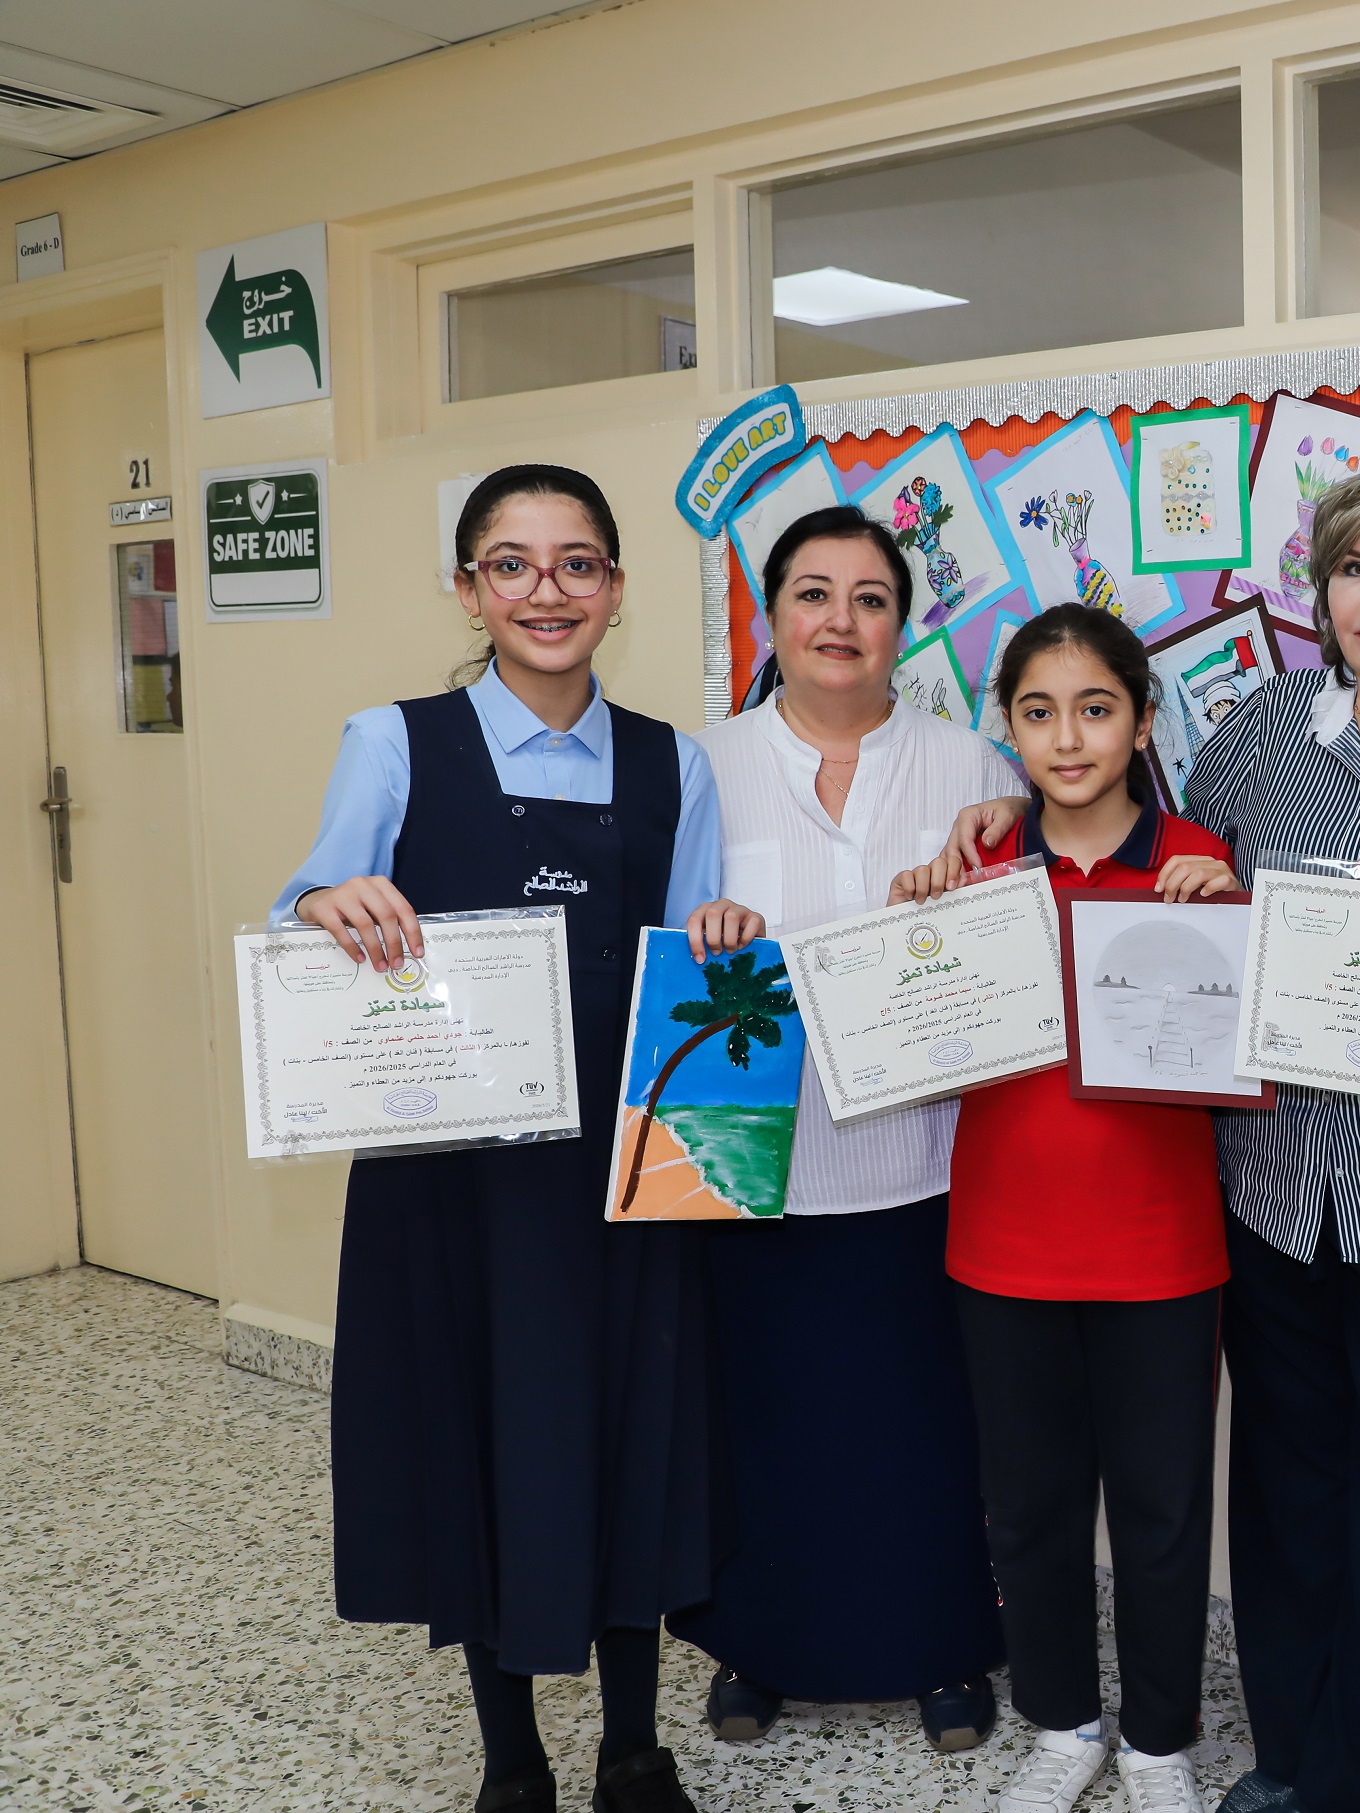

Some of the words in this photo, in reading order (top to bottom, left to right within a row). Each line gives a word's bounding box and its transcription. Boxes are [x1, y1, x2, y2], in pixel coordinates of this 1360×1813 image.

[20, 242, 42, 257] Grade
[43, 240, 48, 252] 6
[53, 237, 60, 249] D
[242, 275, 292, 315] خروج
[243, 310, 294, 339] EXIT
[747, 411, 787, 451] ART
[129, 458, 151, 490] 21
[702, 437, 750, 498] LOVE
[694, 492, 711, 512] I
[213, 532, 261, 562] SAFE
[264, 528, 315, 559] ZONE
[362, 1038, 373, 1046] من
